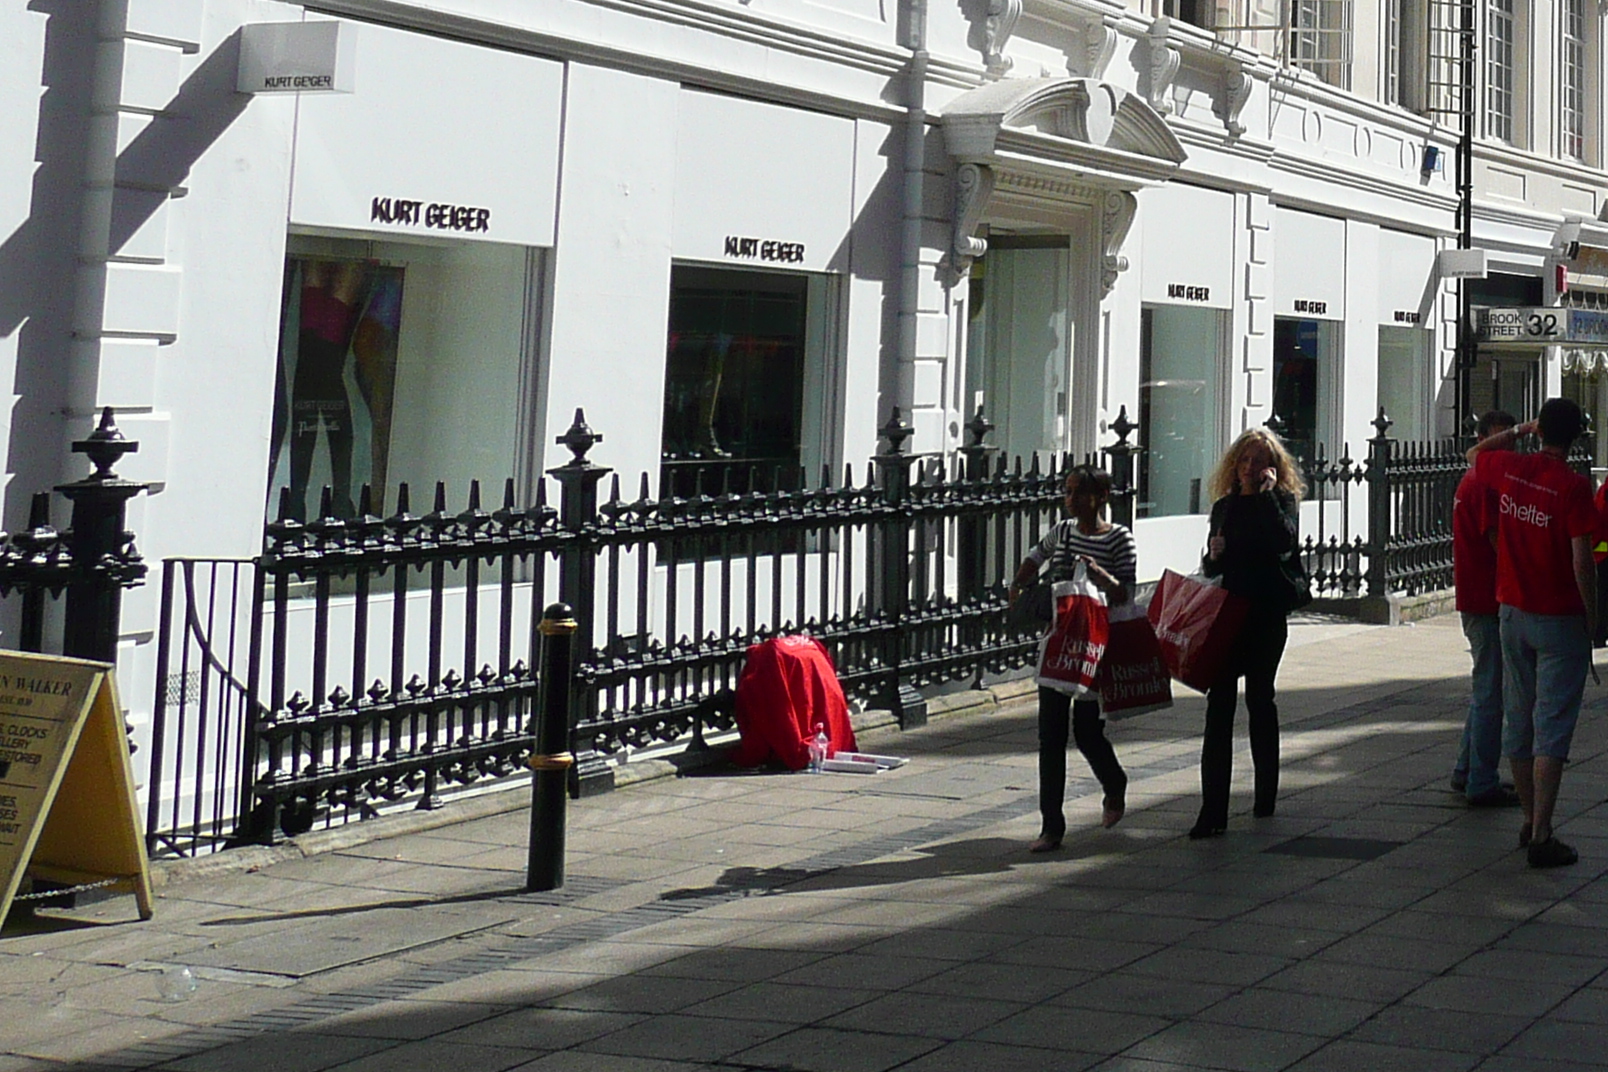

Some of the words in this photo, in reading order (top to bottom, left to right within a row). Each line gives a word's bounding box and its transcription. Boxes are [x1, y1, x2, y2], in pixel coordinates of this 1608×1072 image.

[265, 76, 293, 88] KURT
[294, 76, 331, 87] GEIGER
[371, 196, 423, 226] KURT
[425, 202, 490, 233] GEIGER
[724, 236, 760, 258] KURT
[761, 240, 805, 263] GEIGER
[1168, 284, 1185, 299] KURT
[1186, 286, 1210, 301] GEIGER
[1483, 313, 1522, 324] BROOK
[1528, 314, 1558, 336] 32
[1480, 325, 1522, 337] STREET
[1500, 494, 1552, 528] Shelter
[1061, 635, 1105, 661] Russell
[8, 724, 48, 739] CLOCKS
